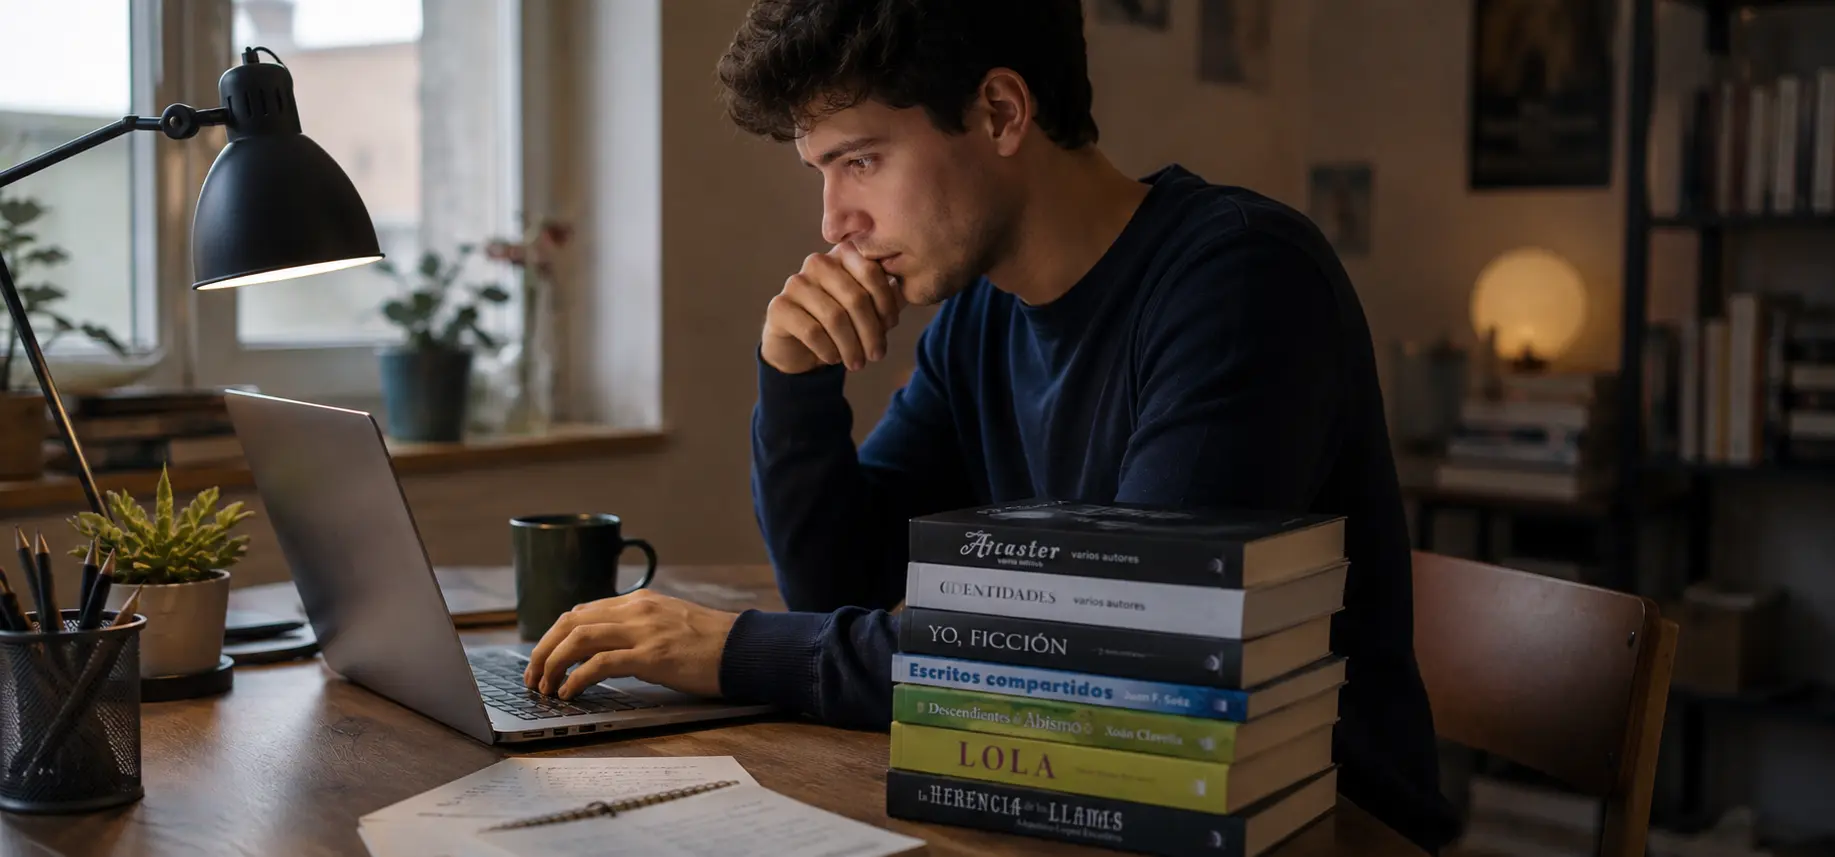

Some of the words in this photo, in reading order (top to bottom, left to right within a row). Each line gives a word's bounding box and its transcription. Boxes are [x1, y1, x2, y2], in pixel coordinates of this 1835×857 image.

[960, 530, 1060, 560] Arcaster
[1071, 550, 1099, 561] varios
[1102, 552, 1139, 564] autores
[1073, 595, 1104, 607] varios
[1106, 598, 1145, 611] autores
[928, 624, 962, 647] YO,
[970, 629, 1068, 656] FICCIÓN
[909, 662, 981, 684] Escritos
[986, 673, 1114, 700] compartidos
[928, 701, 1011, 724] Descendientes
[1023, 711, 1082, 734] Abismo
[957, 740, 1056, 779] LOLA
[929, 785, 1022, 816] HERENCIA
